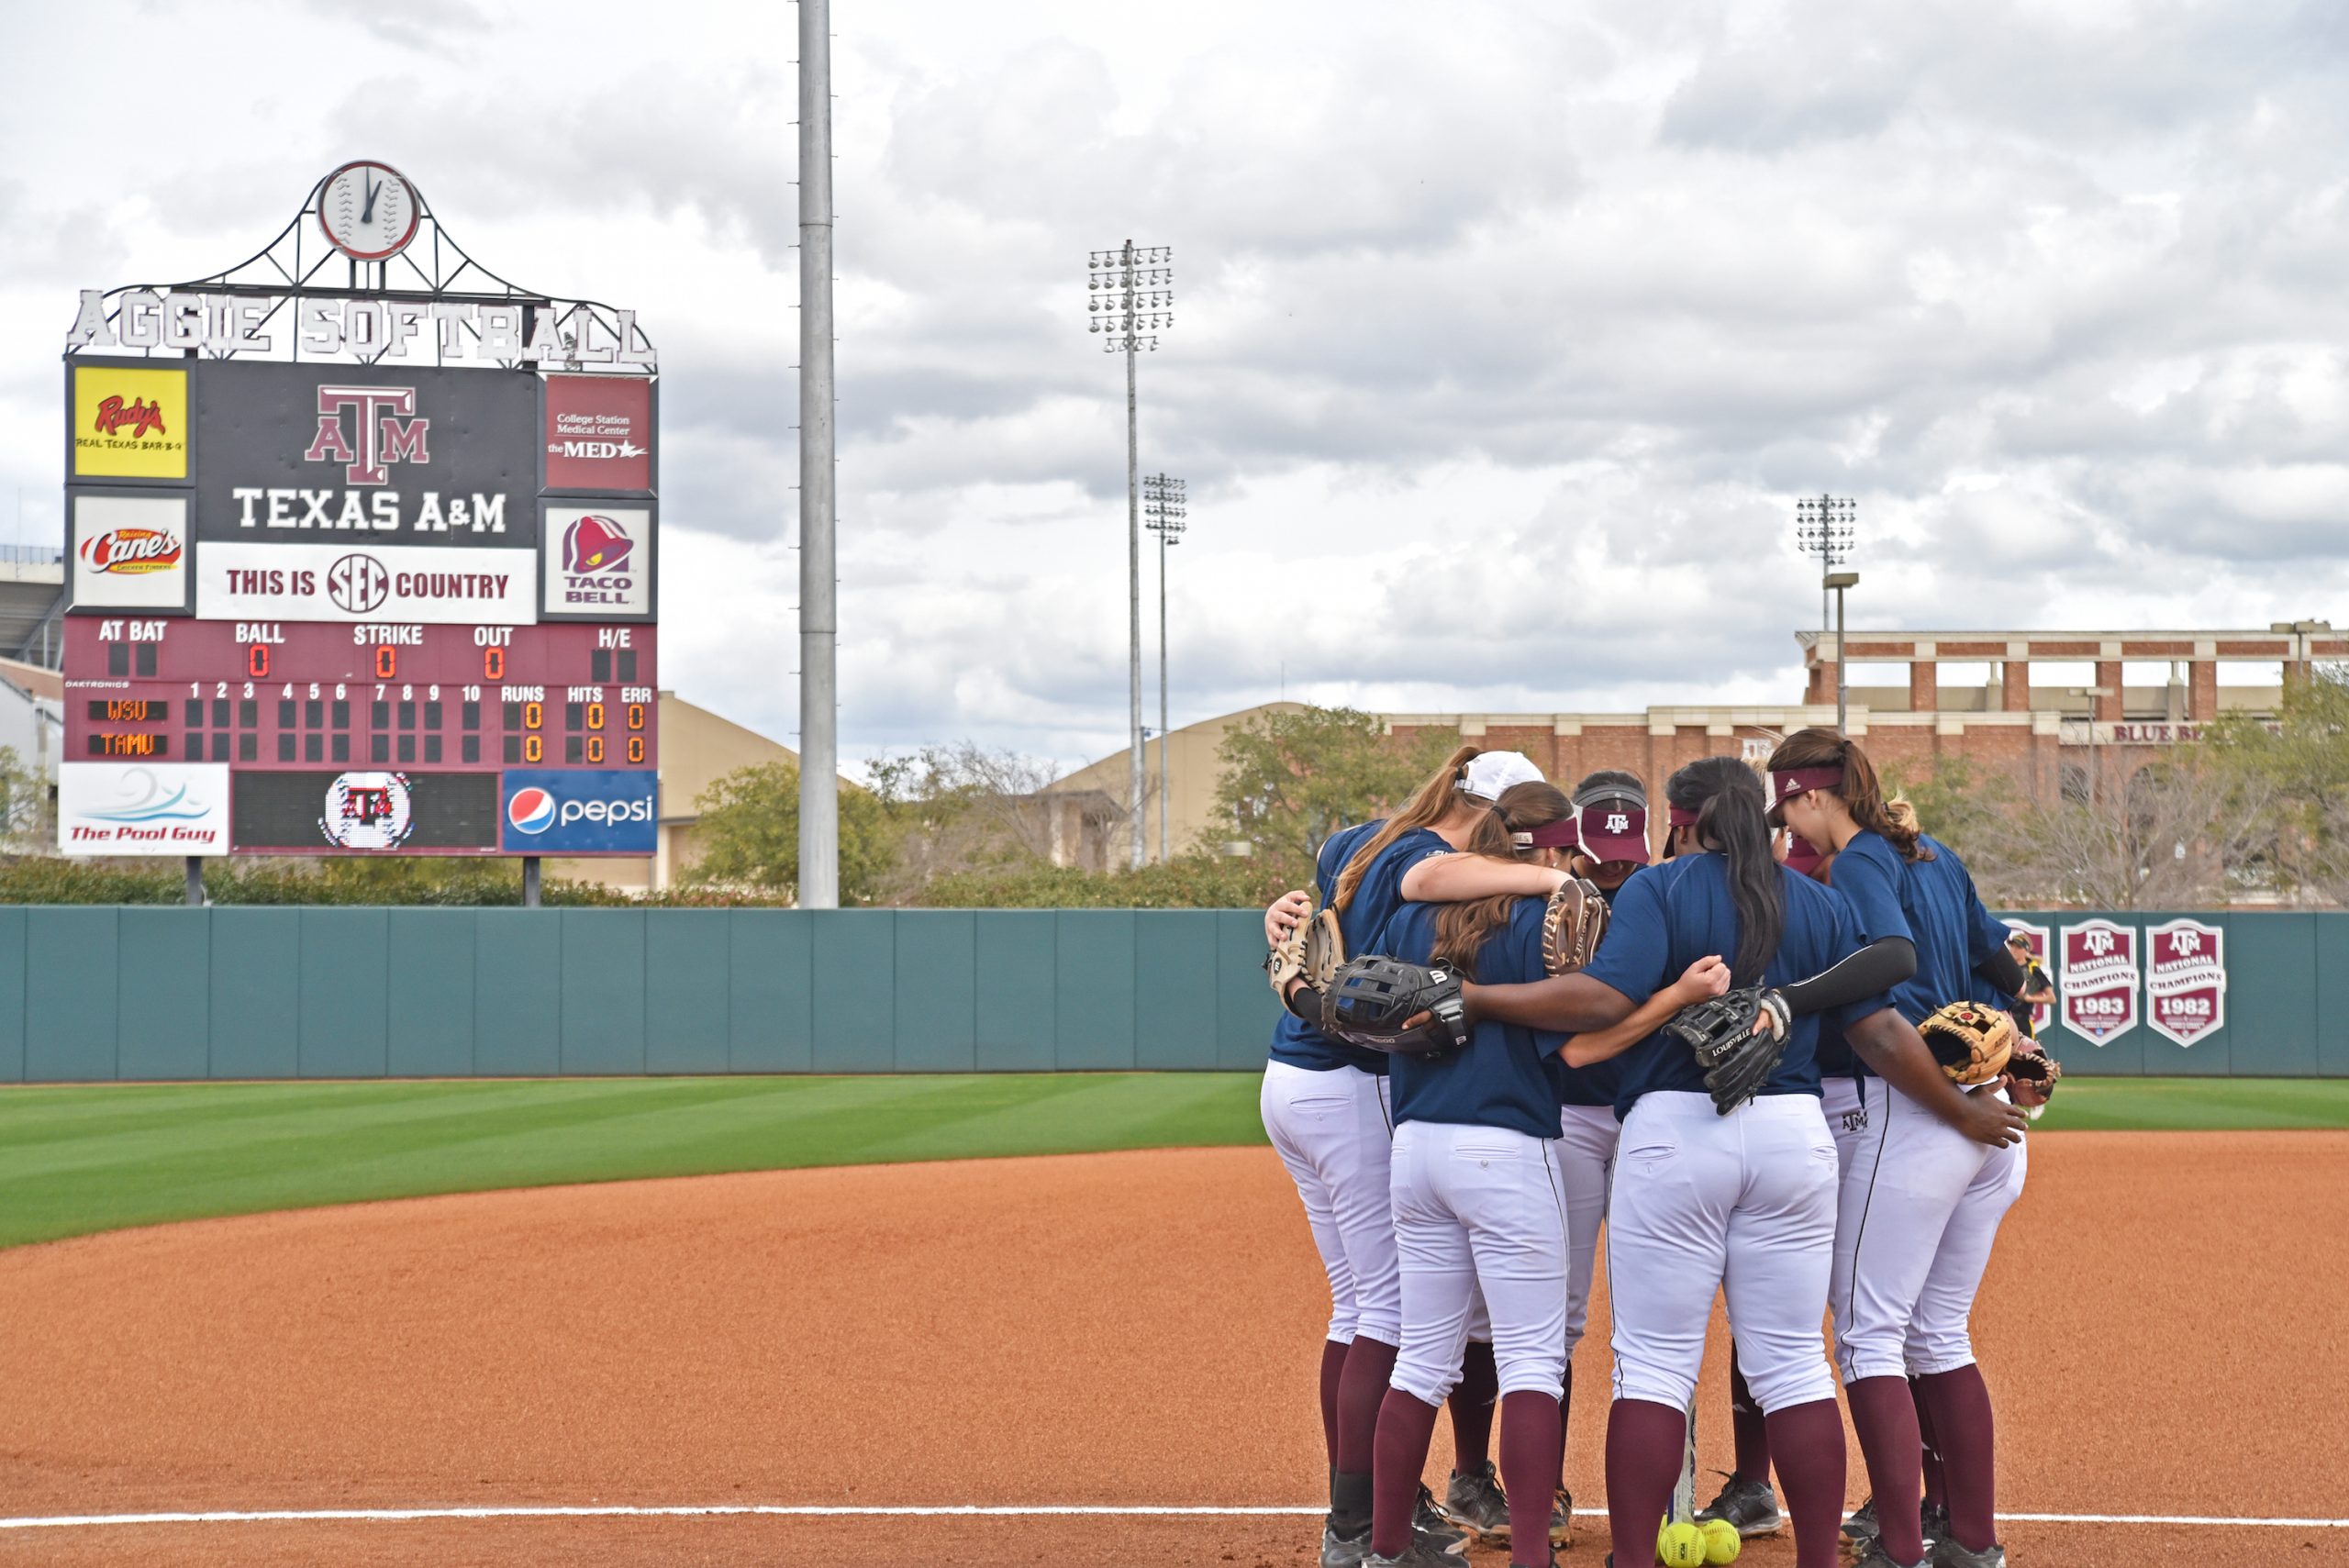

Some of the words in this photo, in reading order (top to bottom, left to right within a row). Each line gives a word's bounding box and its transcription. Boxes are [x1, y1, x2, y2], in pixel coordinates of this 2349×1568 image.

[67, 289, 271, 351] AGGIE
[301, 298, 657, 363] SOFTBALL
[95, 395, 166, 439] Rudy's
[557, 413, 594, 425] College
[596, 414, 630, 426] Station
[557, 424, 596, 435] Medical
[596, 426, 630, 436] Center
[75, 439, 103, 449] REAL
[105, 439, 138, 450] TEXAS
[233, 487, 400, 531] TEXAS
[413, 491, 507, 533] A&M
[84, 528, 182, 574] Cane's
[226, 569, 284, 595] THIS
[291, 570, 317, 596] IS
[395, 573, 510, 600] COUNTRY
[563, 576, 632, 591] TACO
[565, 591, 630, 605] BELL
[99, 620, 123, 641] AT
[129, 620, 168, 642] BAT
[235, 623, 286, 644] BALL
[353, 625, 424, 646] STRIKE
[473, 627, 514, 647] OUT
[598, 628, 632, 650] H/E
[249, 644, 270, 677] 0
[375, 645, 396, 679] 0
[484, 647, 505, 680] 0
[64, 680, 130, 689] DAKTRONICS
[190, 682, 200, 699] 1
[217, 682, 228, 699] 2
[243, 682, 255, 700] 3
[282, 683, 294, 700] 4
[308, 683, 321, 700] 5
[335, 683, 347, 701] 6
[374, 684, 386, 702] 7
[402, 684, 413, 702] 8
[429, 684, 440, 702] 9
[462, 684, 481, 702] 10
[501, 685, 545, 703] RUNS
[567, 685, 604, 703] HITS
[620, 686, 652, 704] ERR
[107, 698, 148, 721] WSU
[525, 702, 542, 729] 0
[587, 702, 605, 729] 0
[628, 704, 644, 729] 0
[2113, 725, 2171, 742] BLUE
[100, 733, 155, 756] TAMU
[525, 735, 542, 762] 0
[587, 736, 605, 762] 0
[628, 737, 644, 762] 0
[561, 795, 653, 828] pepsi
[71, 826, 111, 841] The
[116, 826, 168, 841] Pool
[171, 826, 217, 844] Guy
[2069, 954, 2129, 973] NATIONAL
[2155, 954, 2215, 974] NATIONAL
[2064, 972, 2136, 990] CHAMPIONS
[2150, 973, 2222, 990] CHAMPIONS
[2074, 996, 2125, 1015] 1983
[2160, 997, 2211, 1016] 1982
[1711, 1028, 1752, 1057] LOUISVILLE
